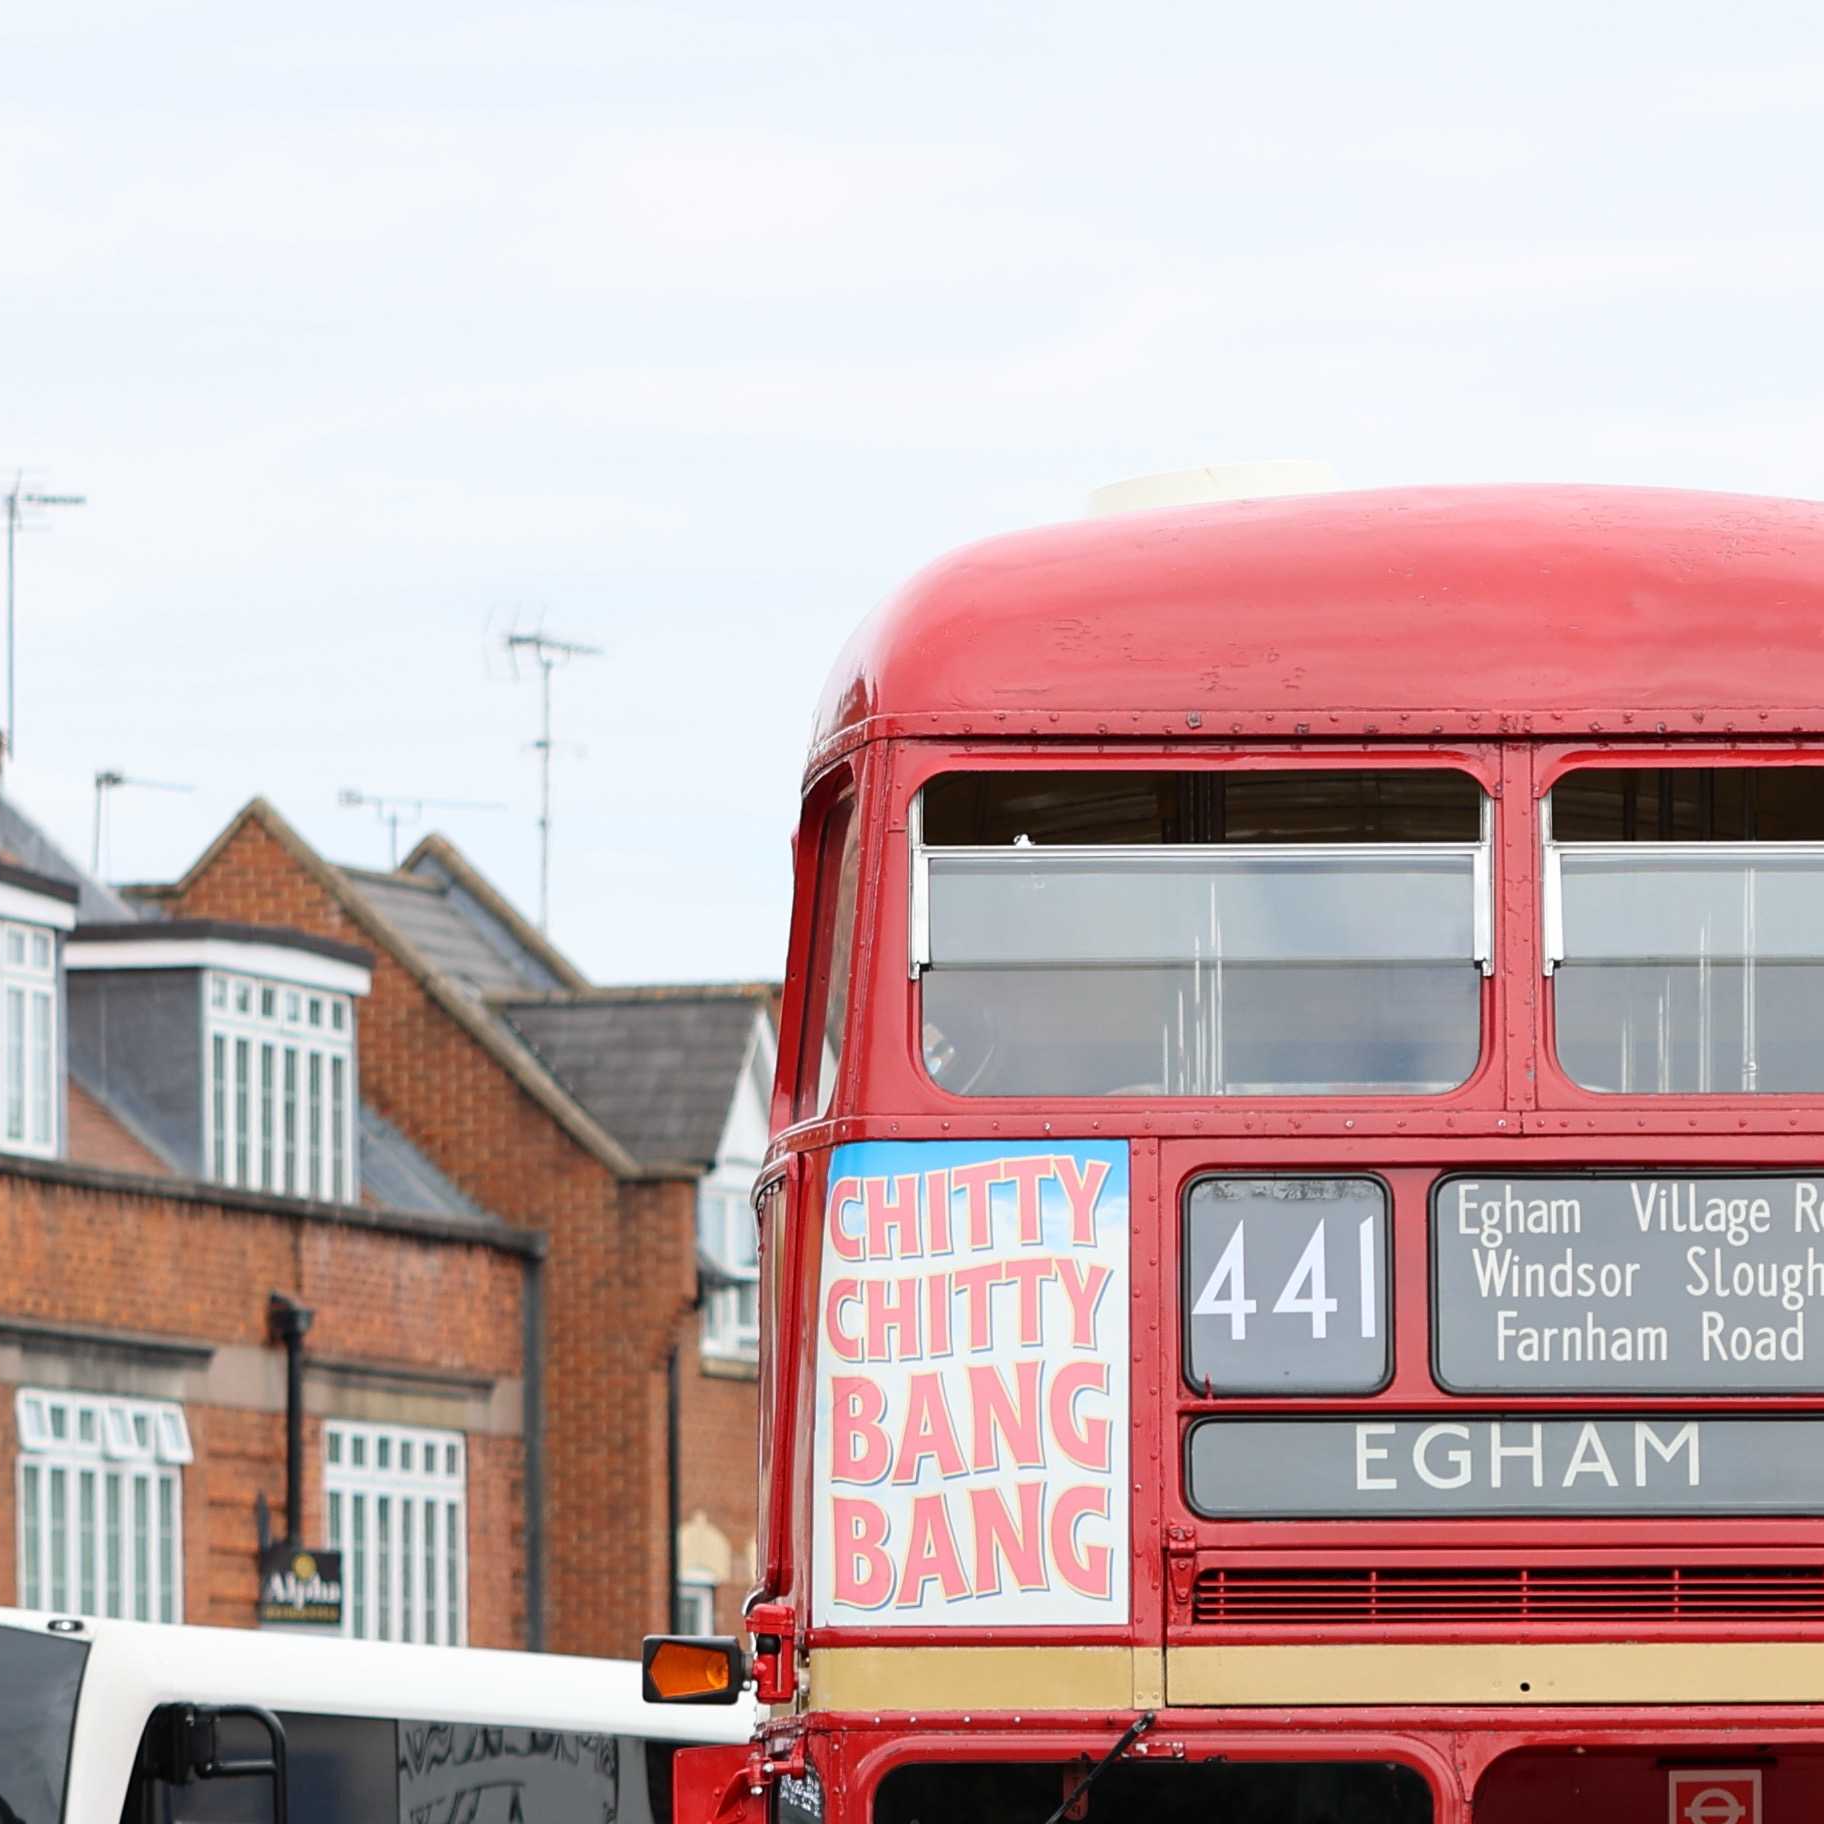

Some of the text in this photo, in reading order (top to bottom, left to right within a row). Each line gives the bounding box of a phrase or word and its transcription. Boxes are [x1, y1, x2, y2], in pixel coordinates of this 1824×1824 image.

[828, 1154, 1112, 1263] CHITTY
[1458, 1183, 1581, 1247] Egham
[1630, 1180, 1770, 1245] Village
[826, 1256, 1111, 1362] CHITTY
[1191, 1215, 1376, 1340] 441
[1472, 1247, 1641, 1299] Windsor
[1496, 1311, 1805, 1363] Farnham Road
[829, 1359, 1112, 1484] BANG
[1355, 1420, 1702, 1490] EGHAM
[830, 1480, 1113, 1612] BANG
